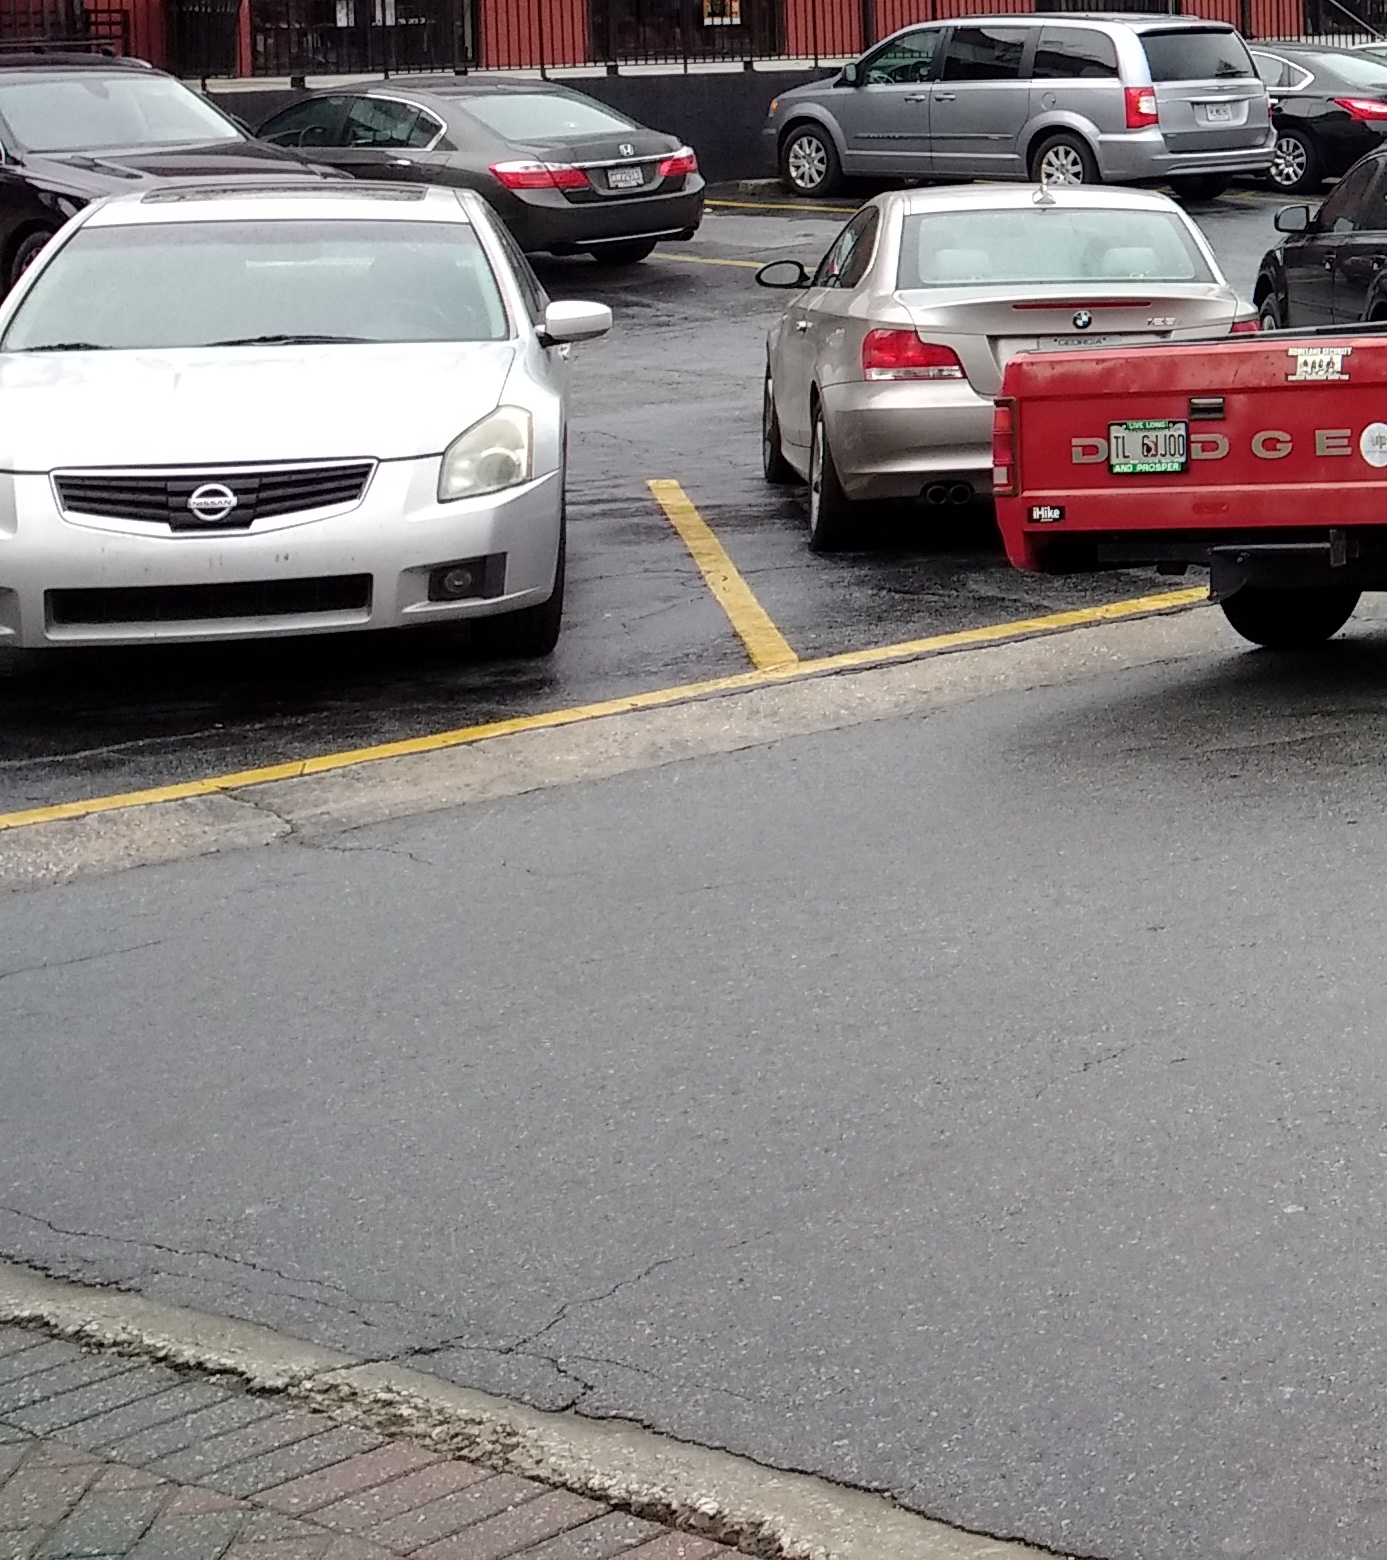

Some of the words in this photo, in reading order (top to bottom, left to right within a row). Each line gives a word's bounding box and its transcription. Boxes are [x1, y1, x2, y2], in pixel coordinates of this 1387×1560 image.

[1129, 421, 1144, 430] LIVE
[1071, 429, 1352, 464] DDGE
[1113, 434, 1131, 459] TL
[1114, 463, 1133, 473] AND
[1136, 462, 1179, 472] PROSPER
[192, 499, 232, 507] NISSAN
[1032, 506, 1061, 519] iHike
